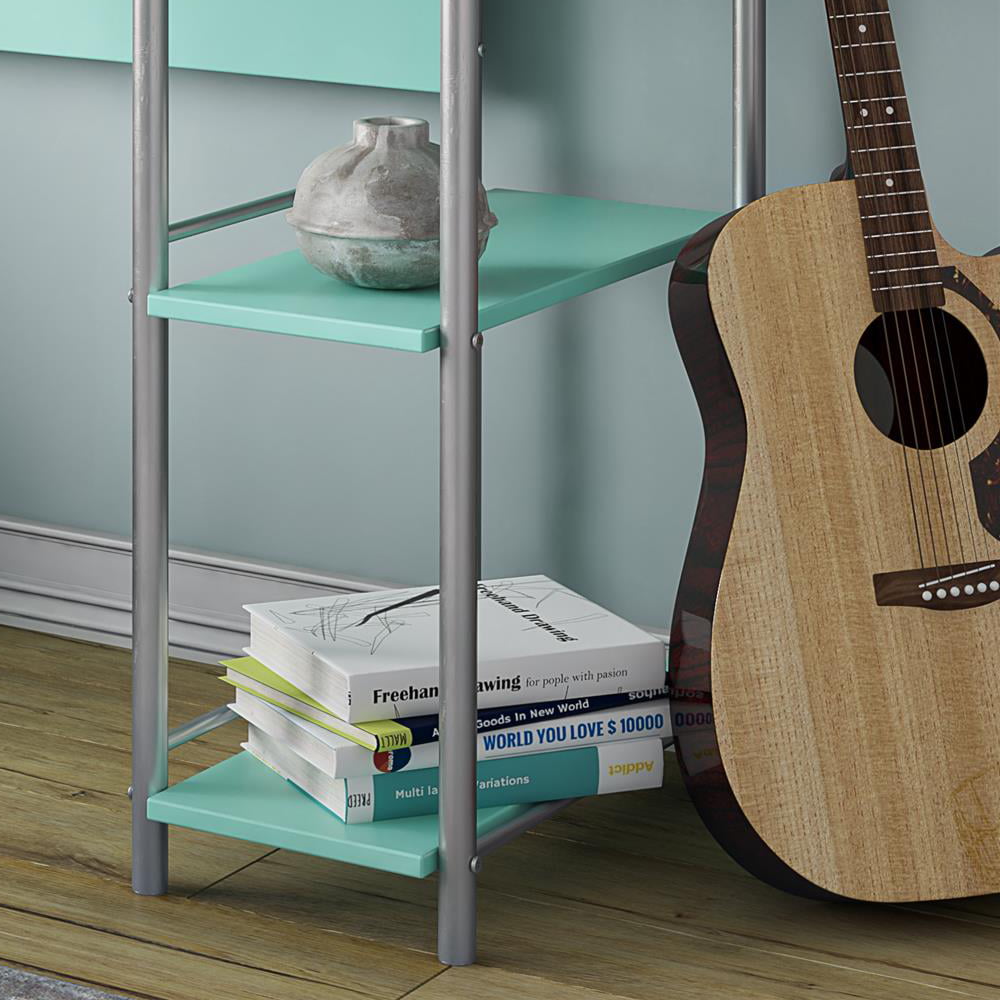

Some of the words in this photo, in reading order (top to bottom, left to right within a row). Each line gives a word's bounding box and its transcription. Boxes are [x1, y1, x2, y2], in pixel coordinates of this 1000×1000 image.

[521, 612, 579, 642] Drawing
[373, 684, 440, 704] Freehan
[525, 678, 540, 688] for
[542, 674, 569, 690] pople
[572, 671, 594, 683] with
[596, 668, 628, 682] pasion
[515, 711, 526, 721] In
[530, 706, 555, 719] New
[557, 698, 590, 714] World
[483, 730, 534, 751] WORLD
[536, 726, 566, 744] YOU
[570, 720, 604, 740] LOVE
[607, 718, 617, 735] $
[620, 712, 664, 733] 10000
[608, 760, 654, 776] Addict
[395, 785, 424, 800] Multi
[477, 774, 530, 790] ariations
